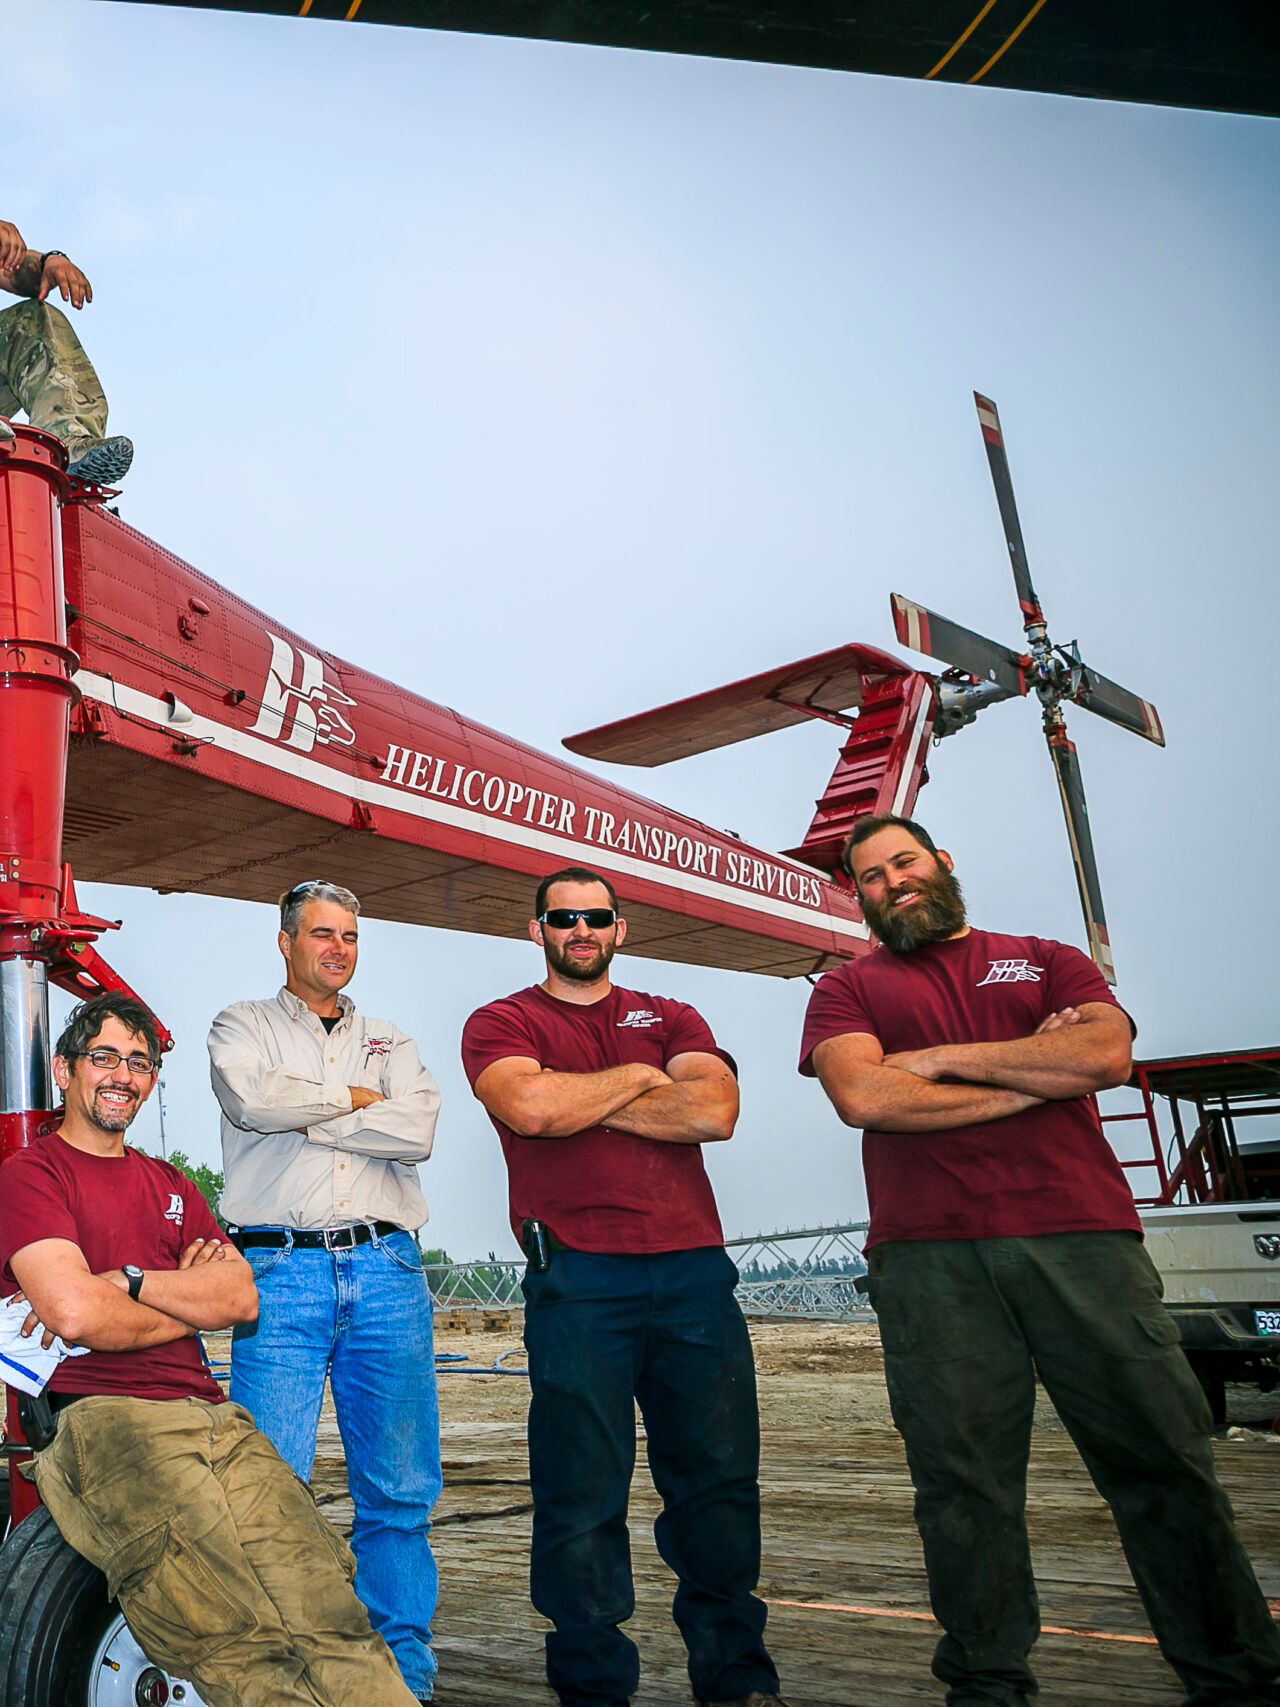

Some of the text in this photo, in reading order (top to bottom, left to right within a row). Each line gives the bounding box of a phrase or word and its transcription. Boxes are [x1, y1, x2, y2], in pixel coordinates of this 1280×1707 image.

[379, 743, 822, 908] HELICOPTER TRANSPORT SERVICES
